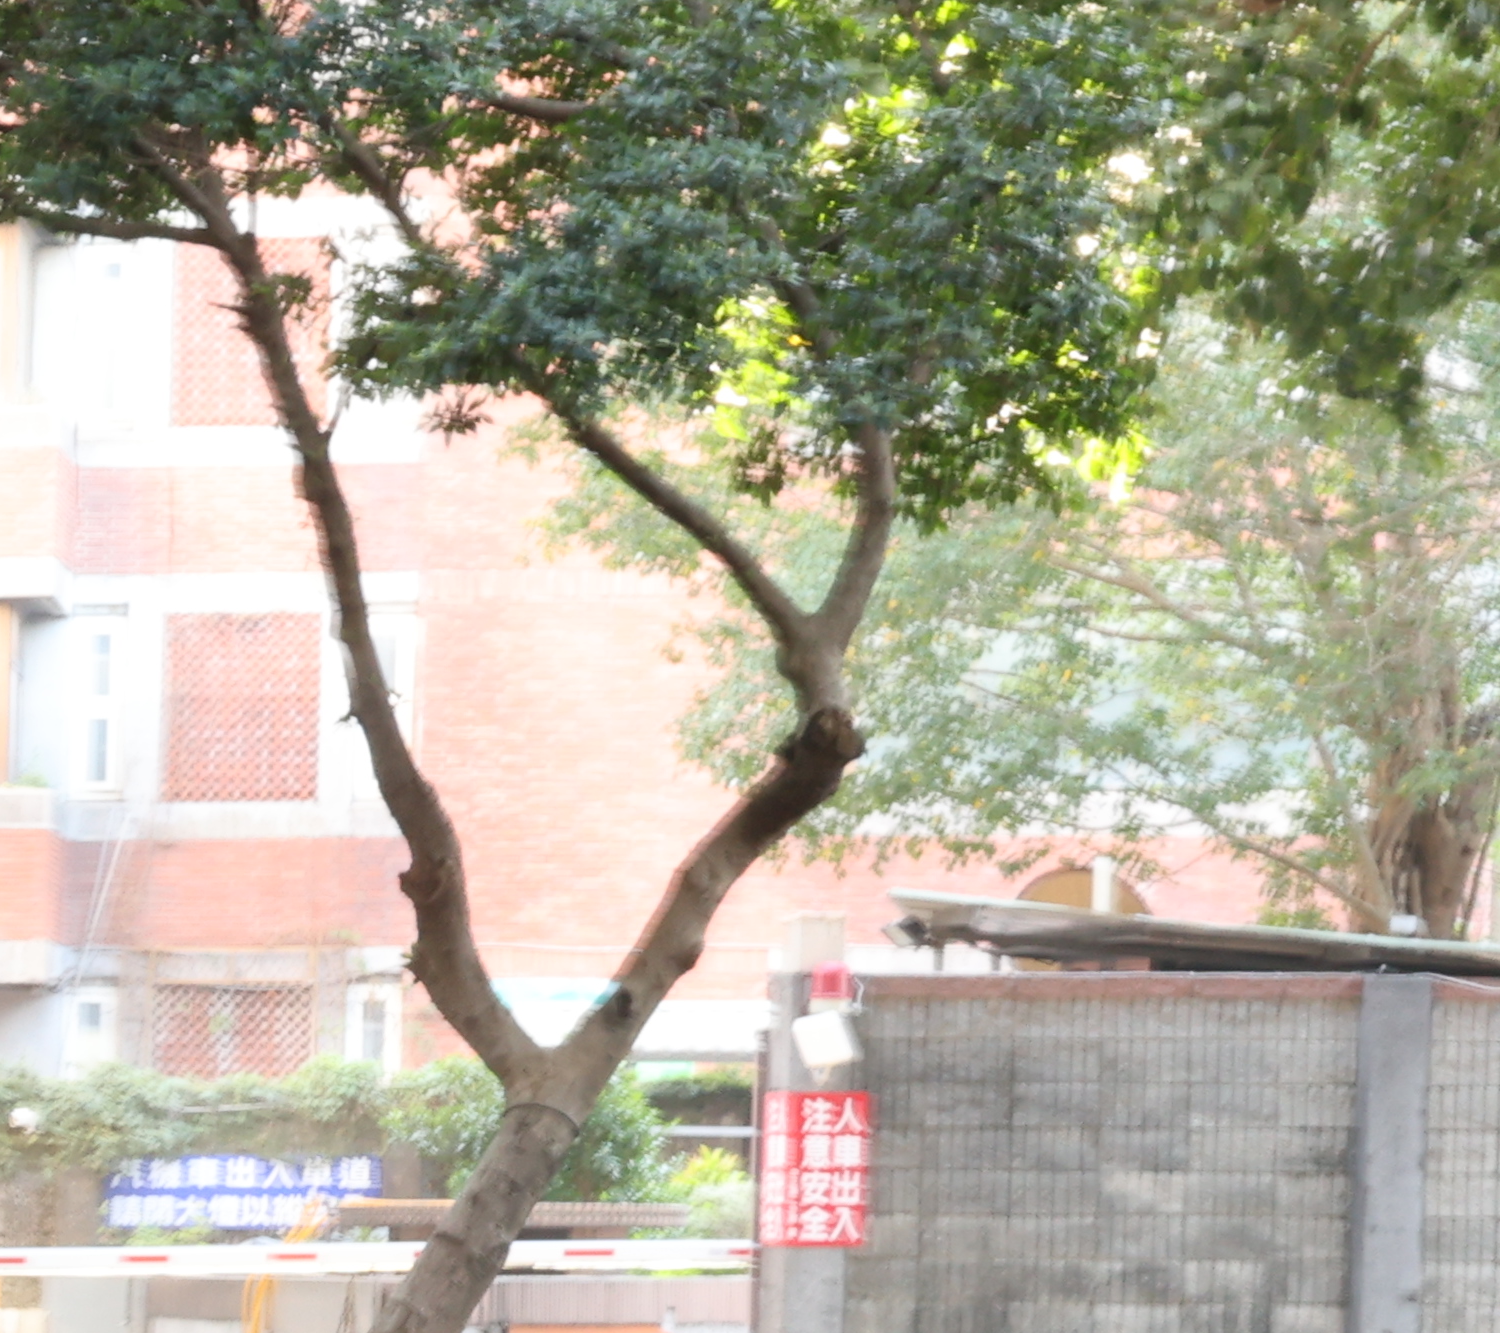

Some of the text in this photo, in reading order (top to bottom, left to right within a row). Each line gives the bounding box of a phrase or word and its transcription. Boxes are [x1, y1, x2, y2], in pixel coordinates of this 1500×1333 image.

[799, 1097, 833, 1242] 注意安全
[829, 1096, 865, 1242] 人車出入
